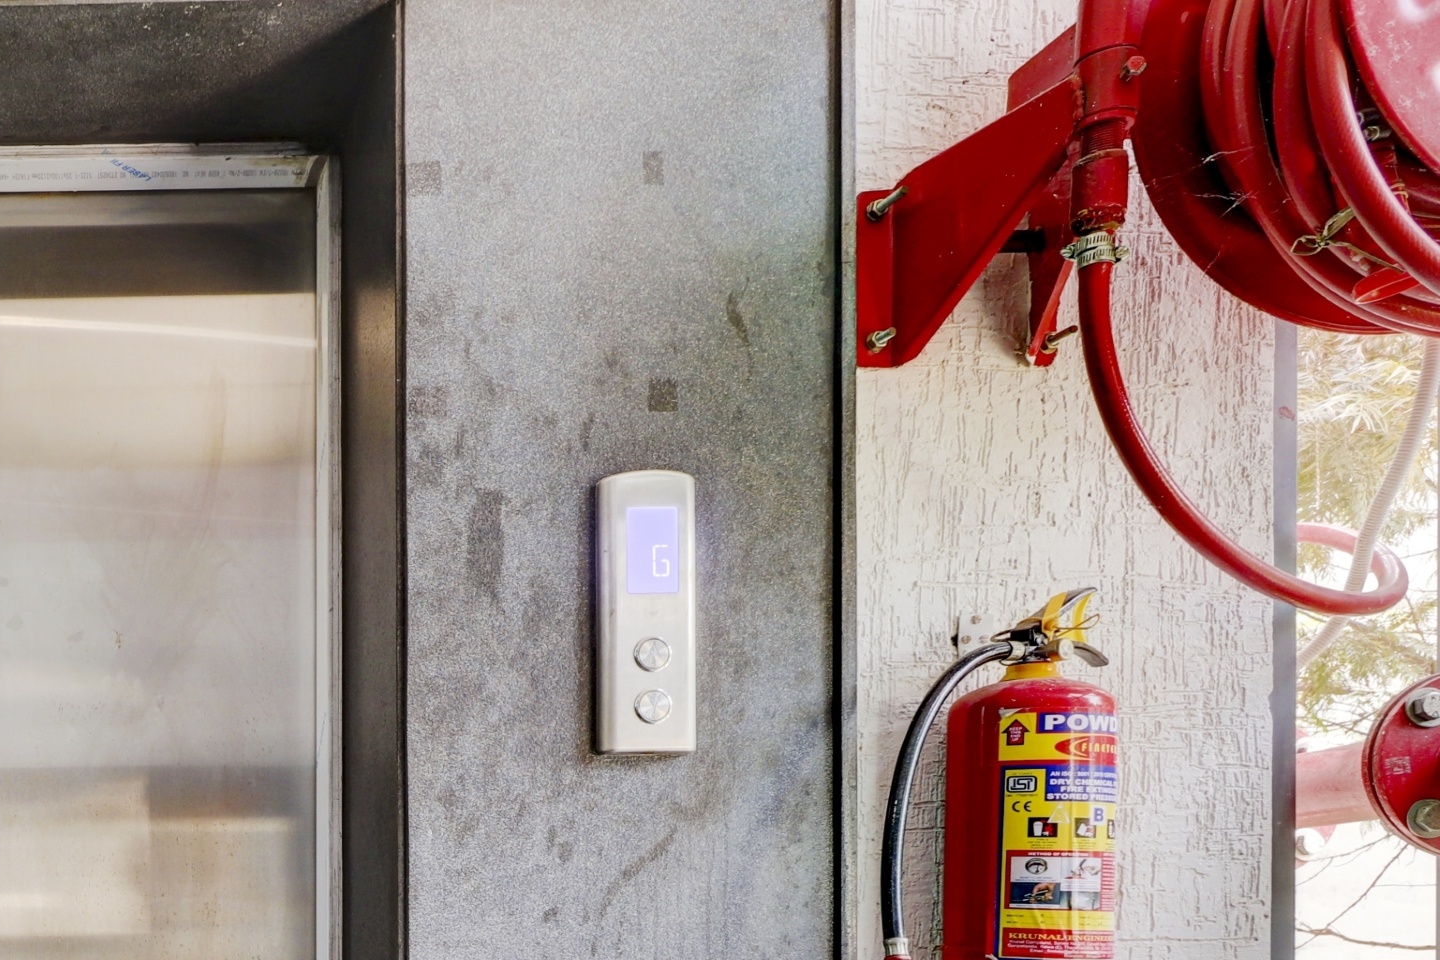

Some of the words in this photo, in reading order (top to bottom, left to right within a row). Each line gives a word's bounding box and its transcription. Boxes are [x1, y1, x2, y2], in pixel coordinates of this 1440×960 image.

[122, 165, 151, 181] LASER
[652, 544, 670, 577] G
[1060, 785, 1084, 793] FIRE
[1012, 801, 1032, 812] CE
[1093, 807, 1104, 822] B
[1008, 932, 1065, 941] KRUNAL
